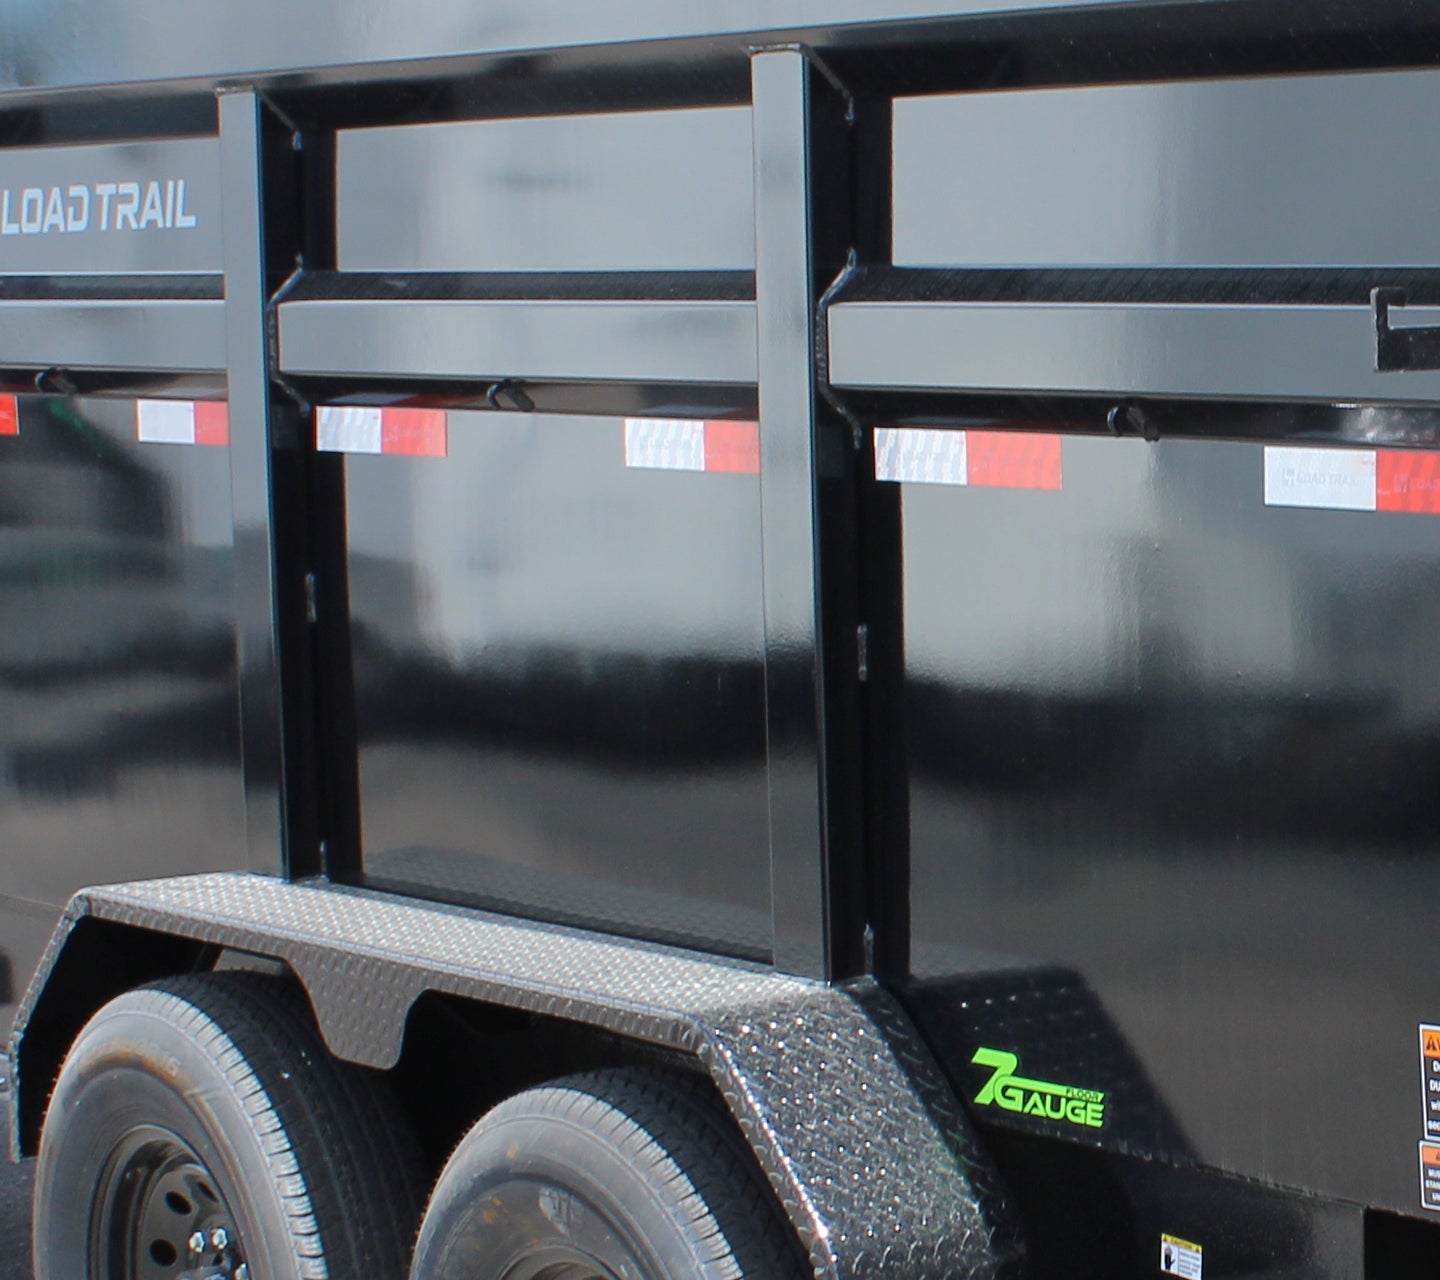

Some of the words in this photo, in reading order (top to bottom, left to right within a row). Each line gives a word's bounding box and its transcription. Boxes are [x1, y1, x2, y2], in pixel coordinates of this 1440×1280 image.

[1, 185, 90, 234] LOAD
[95, 179, 196, 231] TRAIL
[971, 1047, 1017, 1105] 7
[993, 1074, 1104, 1128] GAUGE
[1066, 1087, 1100, 1103] FLOOR
